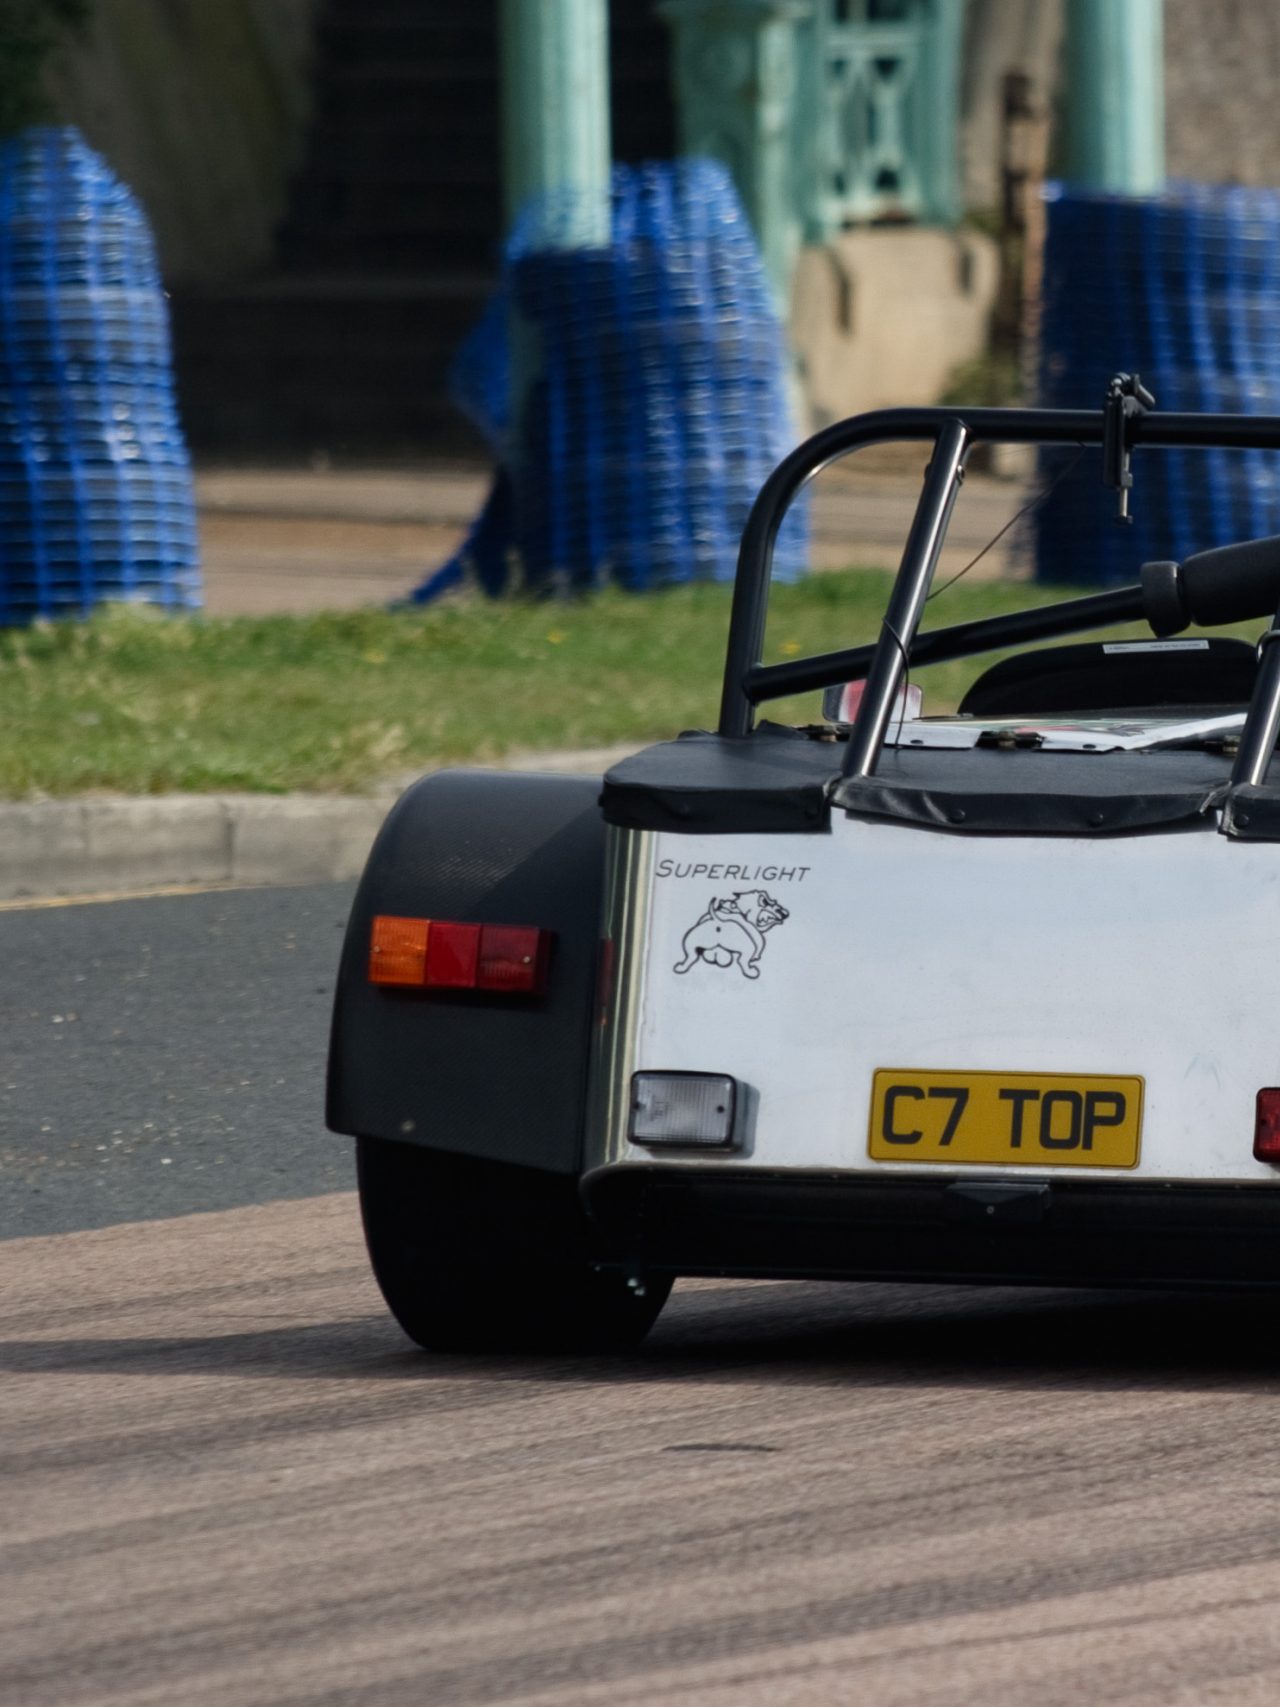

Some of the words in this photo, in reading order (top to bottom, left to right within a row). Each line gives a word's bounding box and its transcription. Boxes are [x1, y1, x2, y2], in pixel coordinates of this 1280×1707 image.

[656, 859, 811, 882] SUPERLIGHT
[882, 1085, 969, 1146] C7
[999, 1088, 1126, 1150] TOP
